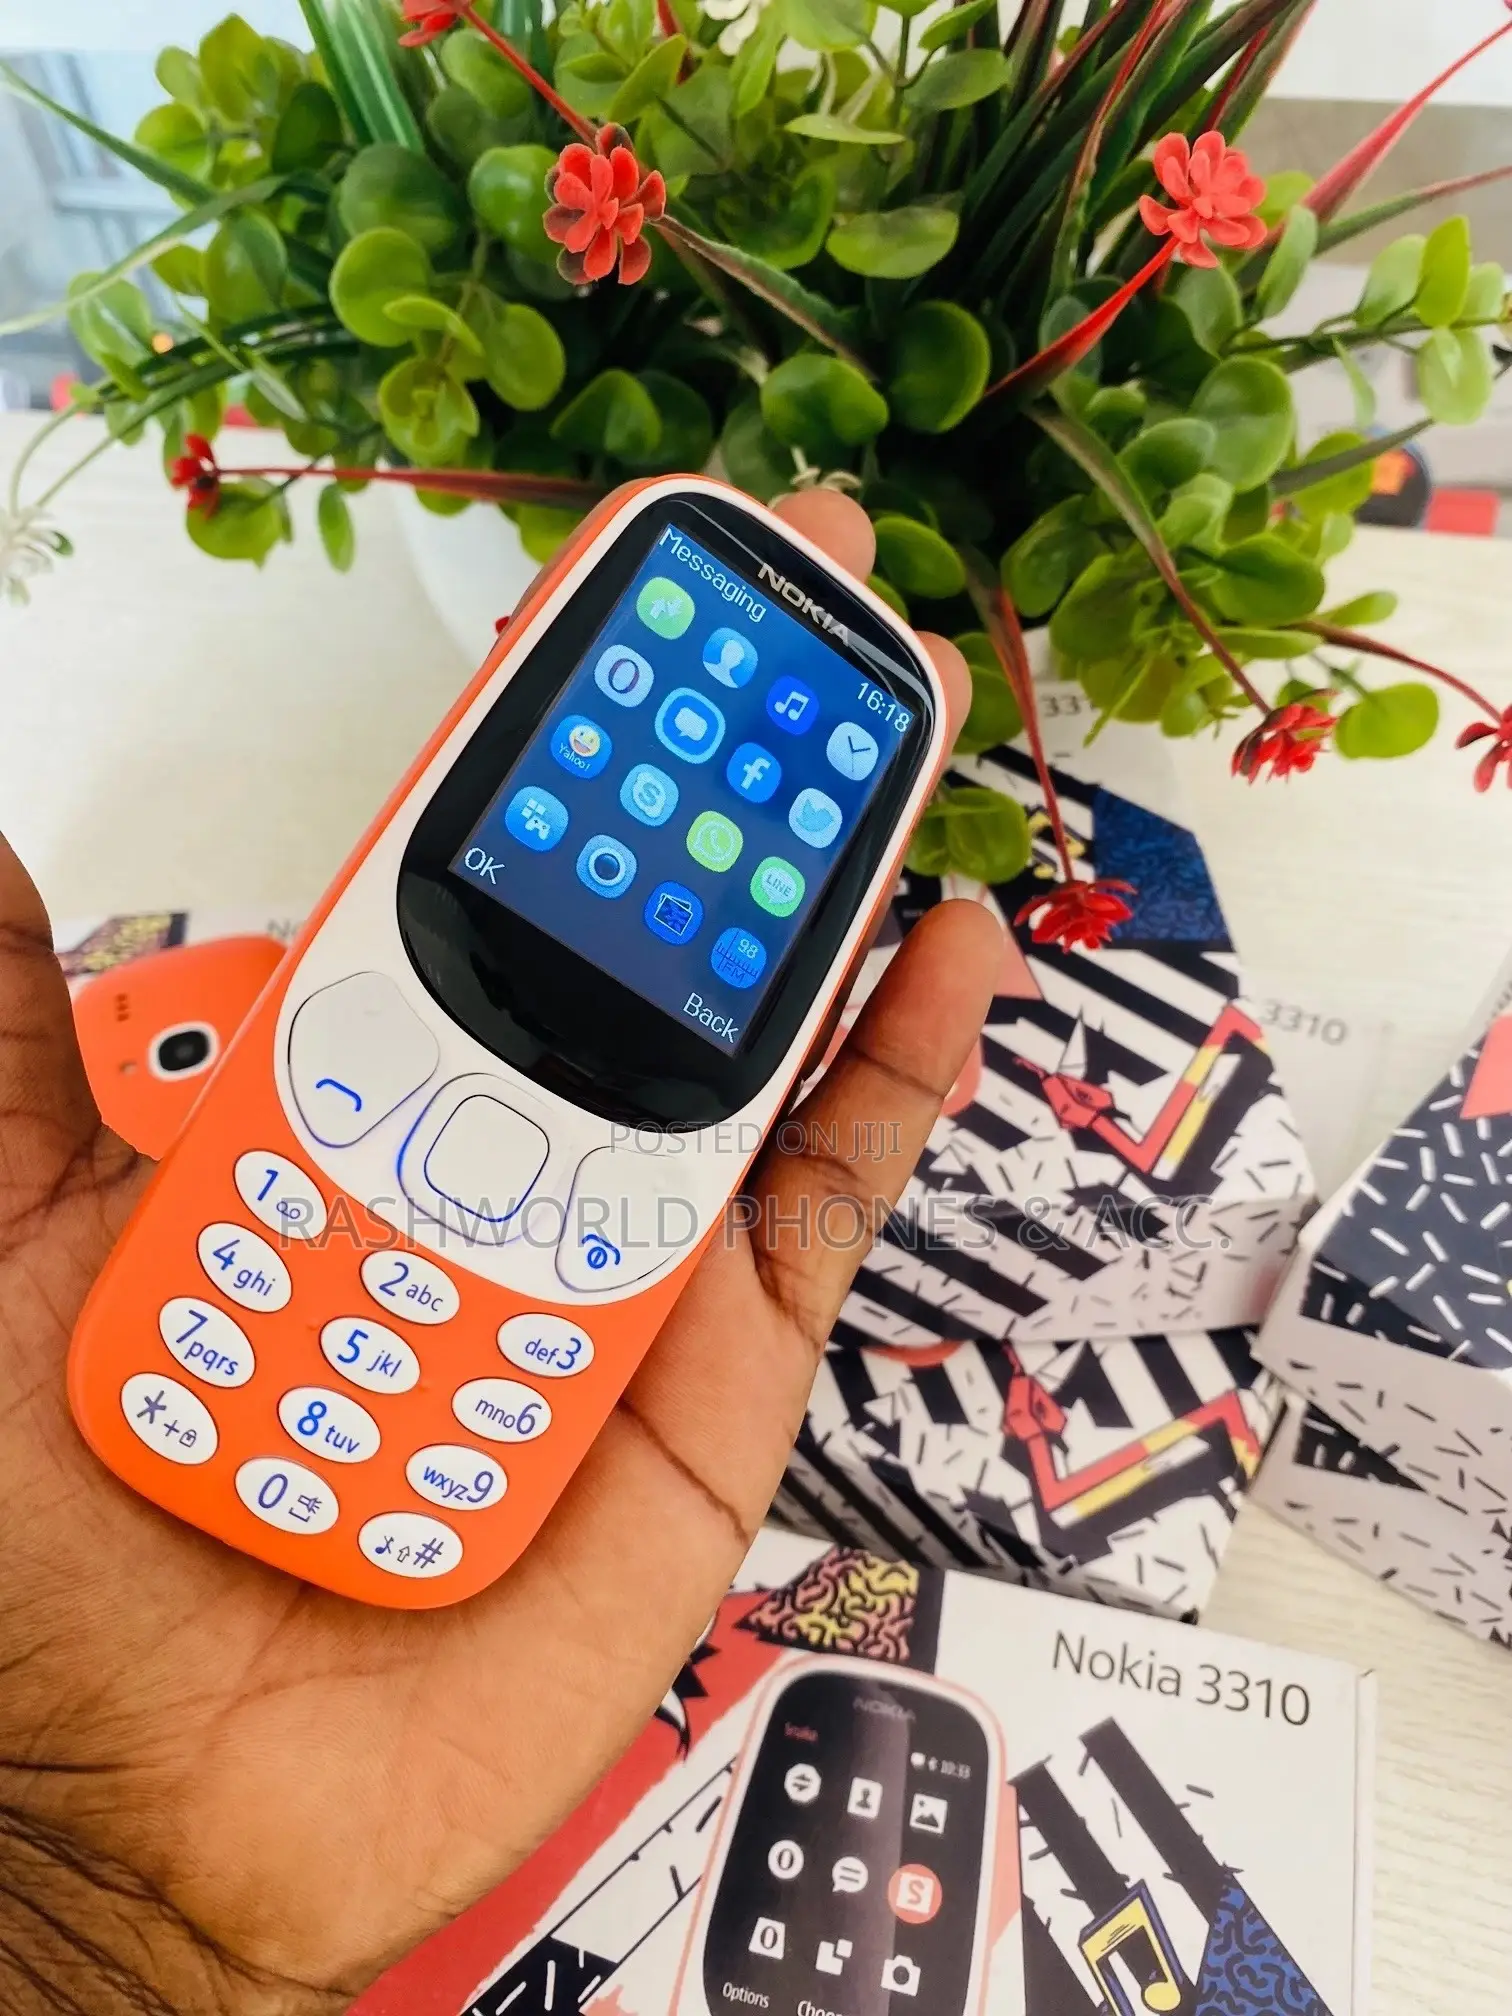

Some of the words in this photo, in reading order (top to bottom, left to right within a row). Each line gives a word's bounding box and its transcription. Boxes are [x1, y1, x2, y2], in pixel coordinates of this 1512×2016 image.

[659, 527, 767, 623] Messaging
[757, 563, 854, 647] NOKIA
[856, 681, 911, 734] 16:18
[559, 743, 591, 771] Yahoo!
[464, 847, 505, 885] OK
[766, 874, 792, 897] LINE
[737, 939, 759, 959] 98
[682, 993, 739, 1043] Back
[256, 1168, 279, 1202] 1
[1052, 1629, 1182, 1697] Nokia
[1196, 1663, 1310, 1726] 3310
[722, 1981, 770, 2009] Options
